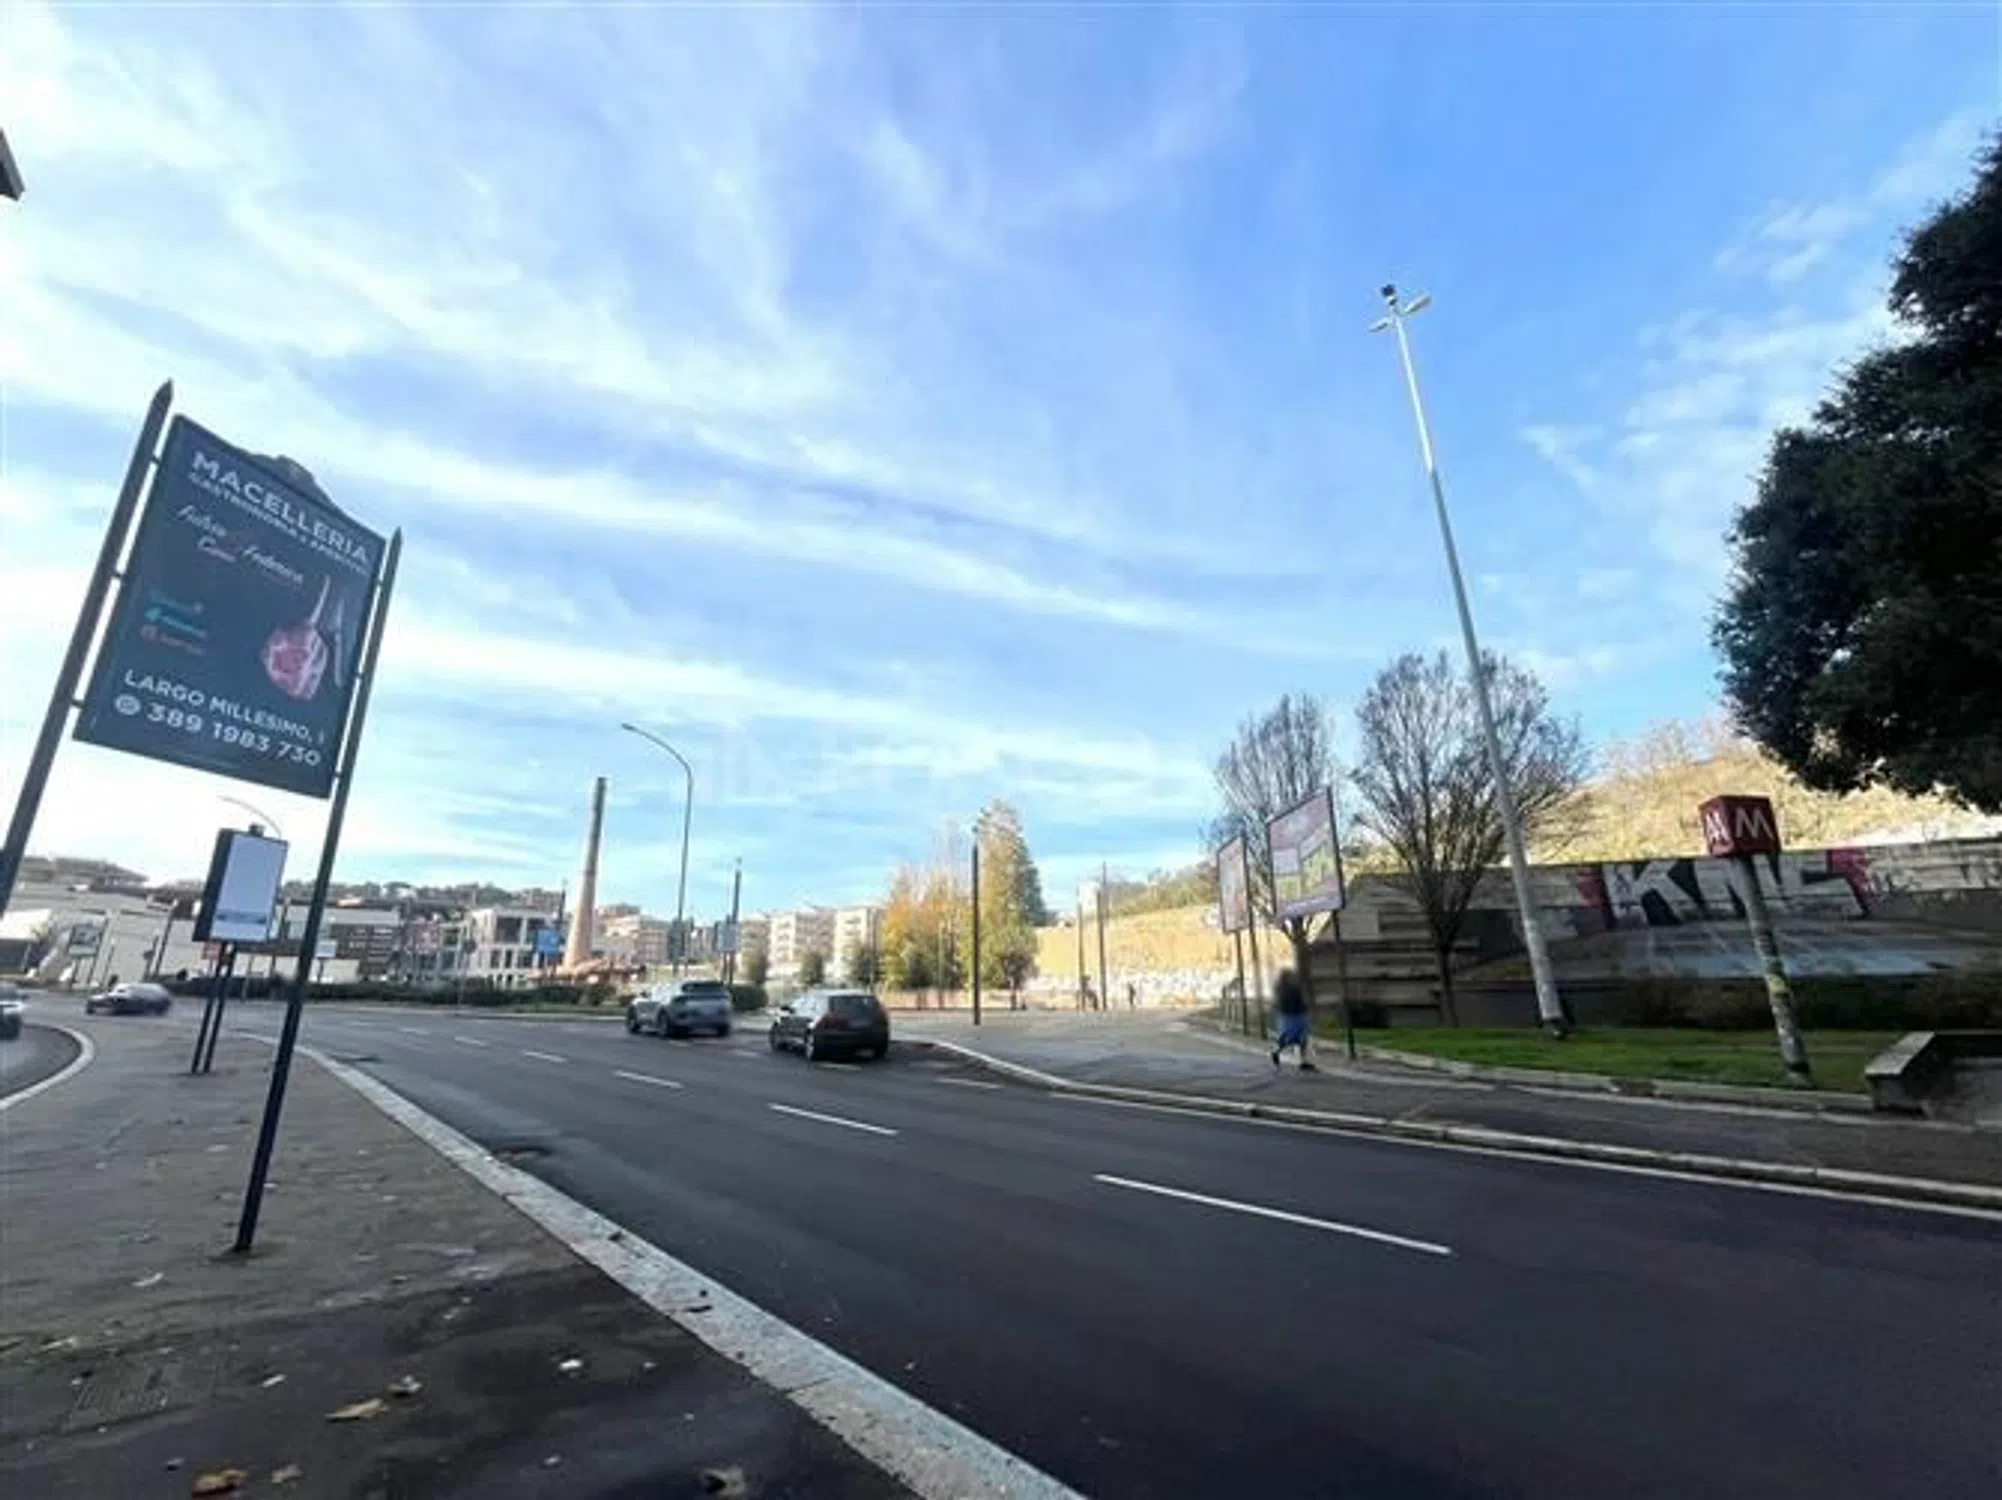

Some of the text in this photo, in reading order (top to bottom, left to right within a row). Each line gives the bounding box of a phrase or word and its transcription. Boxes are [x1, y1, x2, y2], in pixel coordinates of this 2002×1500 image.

[192, 451, 369, 565] MACELLERIA
[124, 669, 205, 706] LARGO
[209, 696, 313, 744] MILLESIMO,
[147, 702, 321, 766] 389 1983 730
[1735, 807, 1774, 839] M
